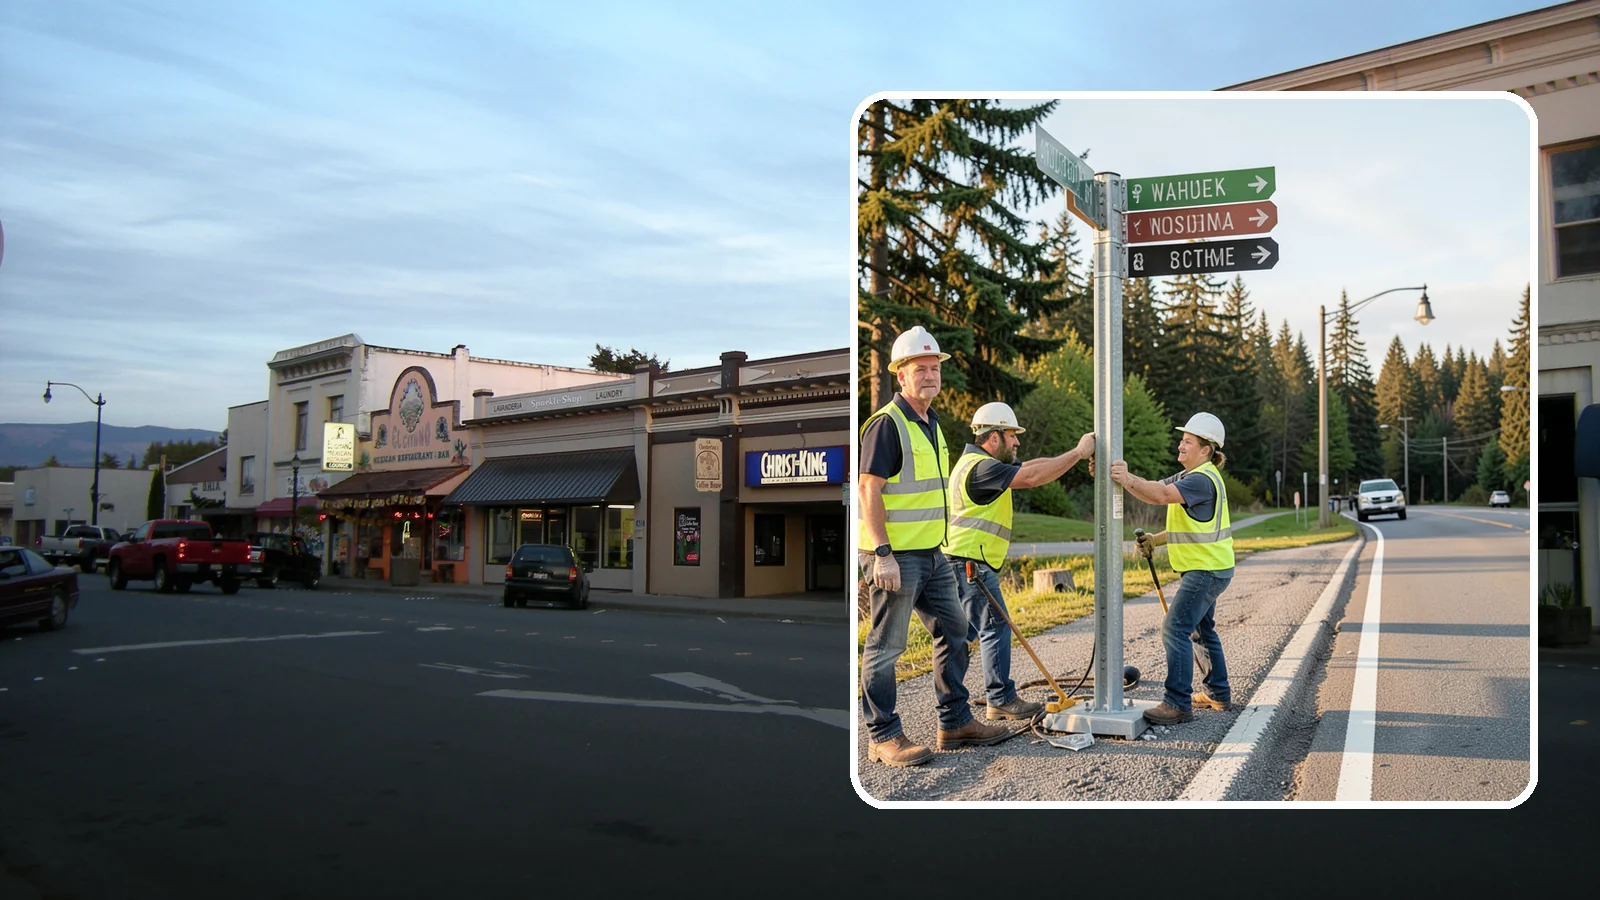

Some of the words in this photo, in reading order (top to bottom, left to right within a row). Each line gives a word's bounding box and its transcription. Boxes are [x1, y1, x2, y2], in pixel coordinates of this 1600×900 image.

[595, 389, 623, 399] LAUNDRY
[493, 402, 522, 412] LAVANDERIA
[531, 399, 560, 409] Sparkle
[562, 394, 582, 405] Shop
[373, 455, 396, 464] MEXICAN
[397, 452, 433, 462] RESTAURANT
[438, 450, 450, 459] BAR
[760, 451, 796, 478] CHRIST
[799, 449, 827, 476] KING
[696, 481, 709, 489] Coffee
[710, 481, 722, 489] House
